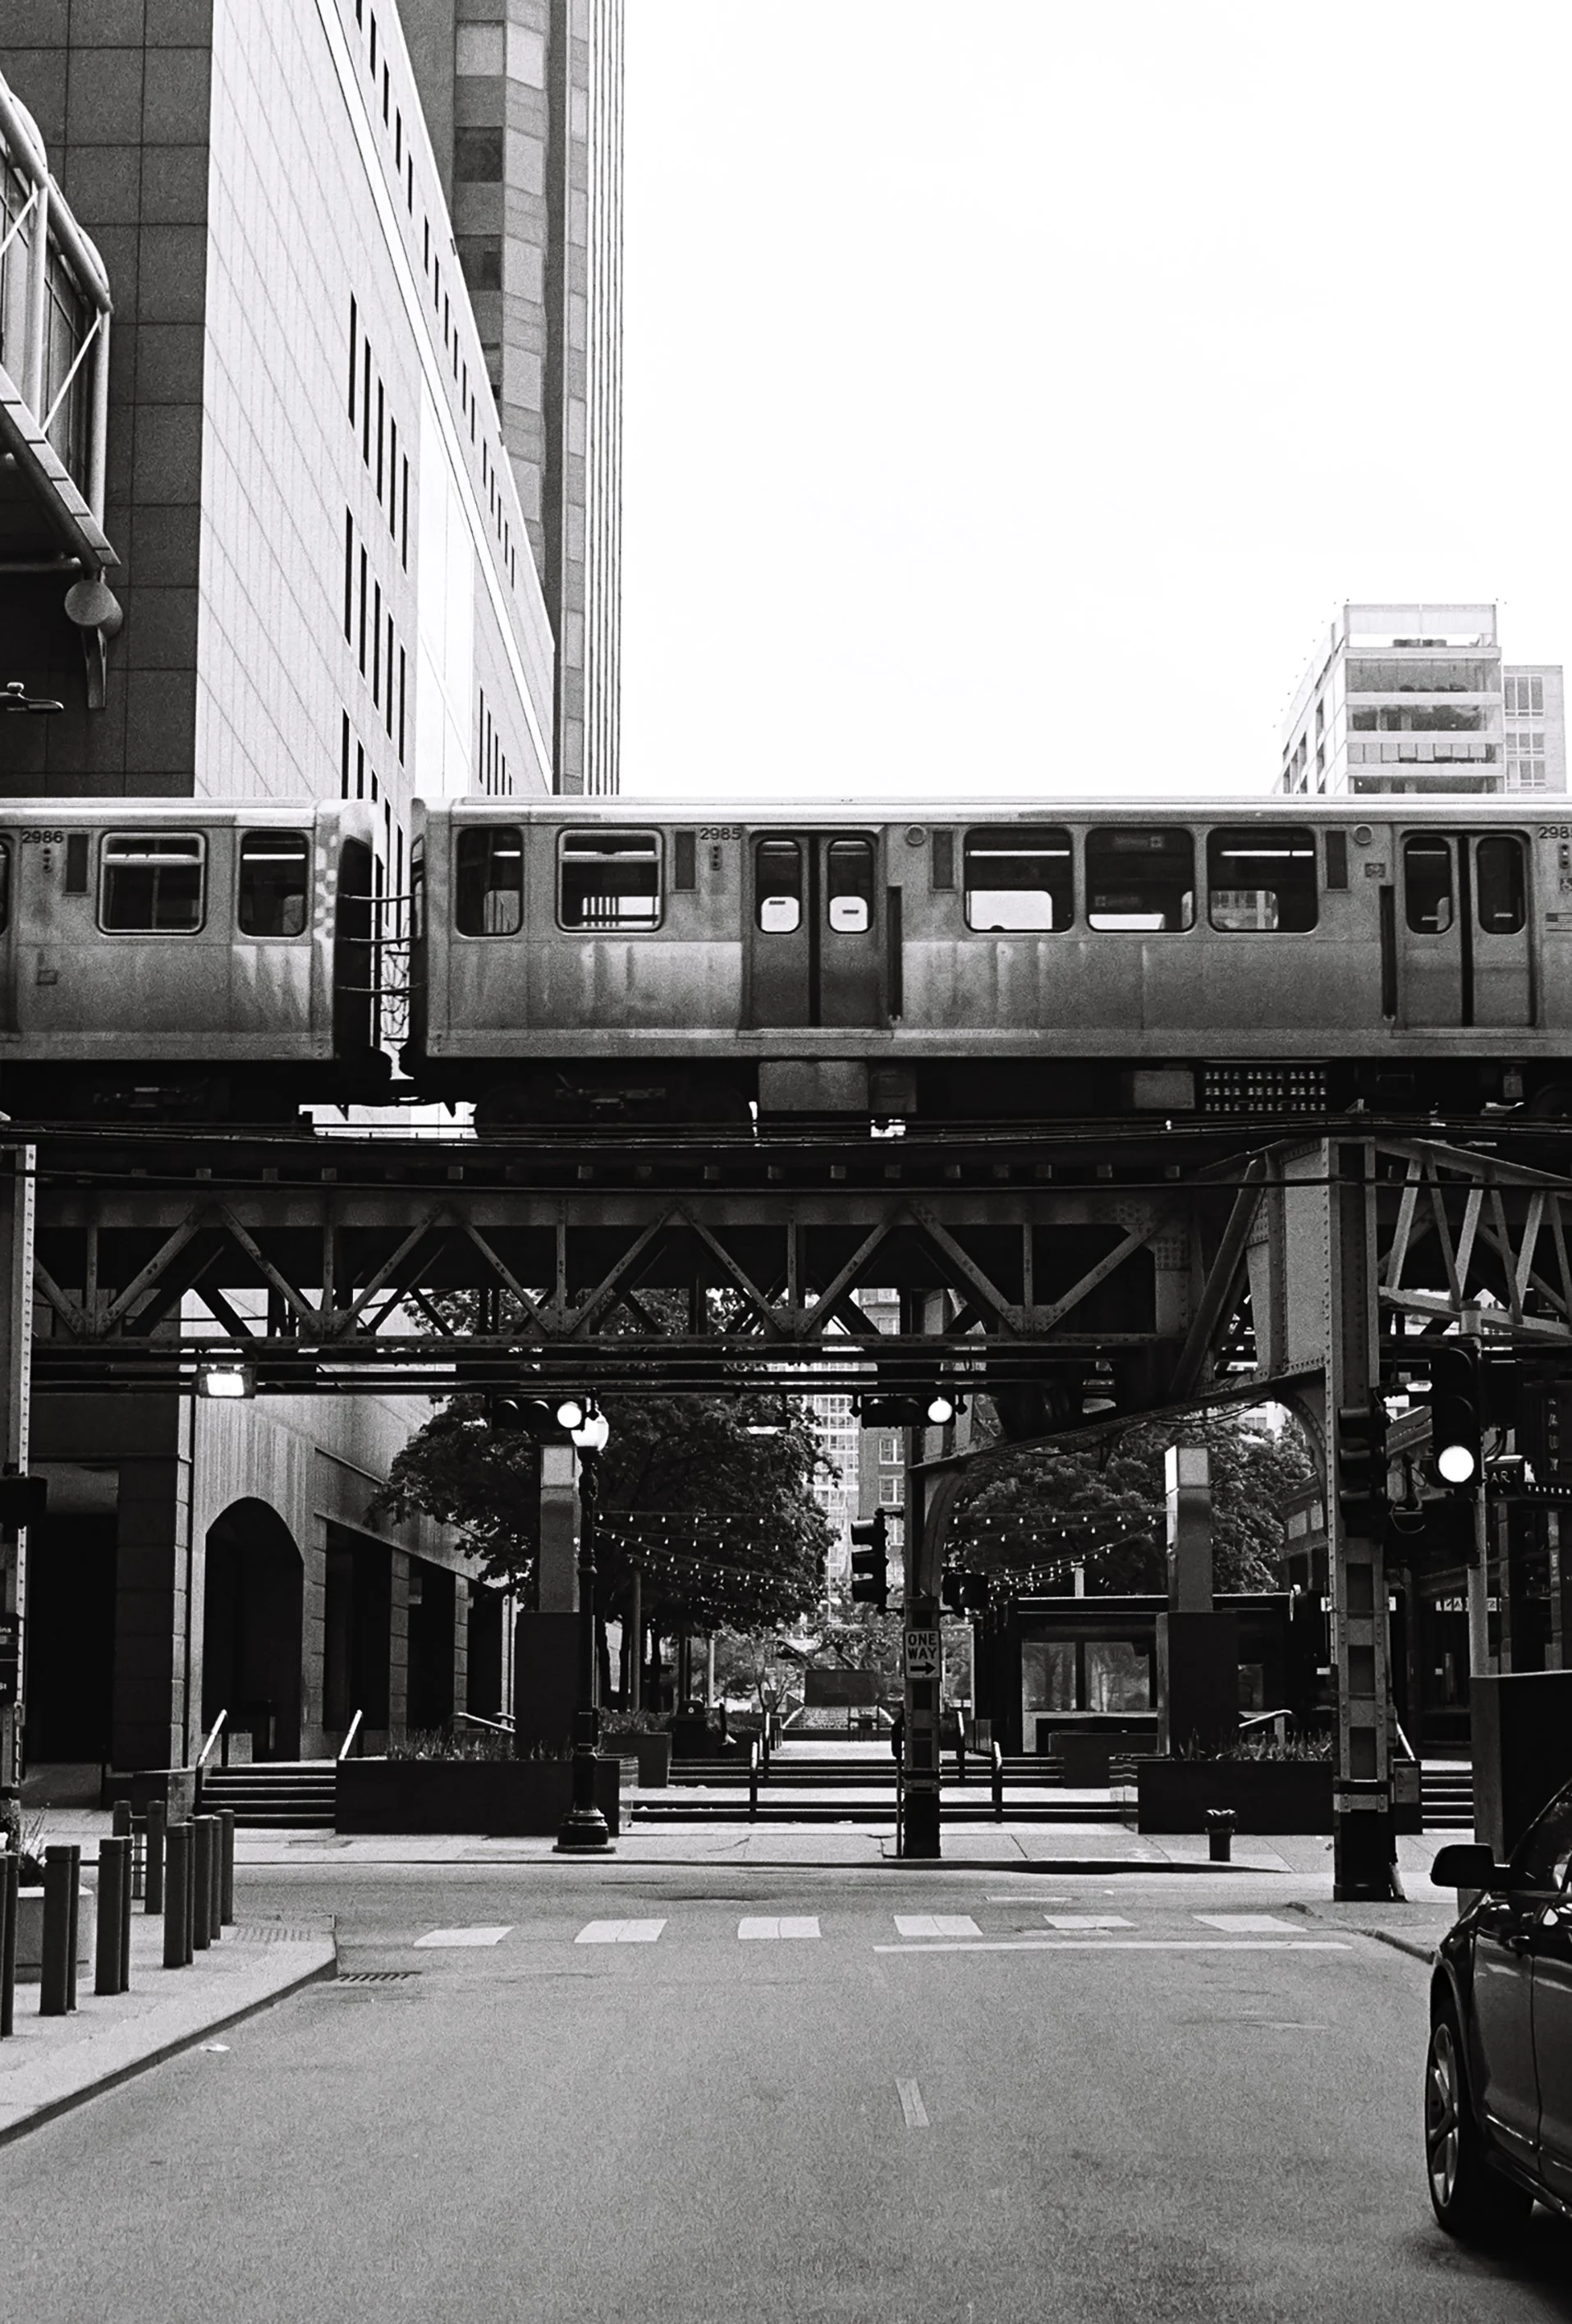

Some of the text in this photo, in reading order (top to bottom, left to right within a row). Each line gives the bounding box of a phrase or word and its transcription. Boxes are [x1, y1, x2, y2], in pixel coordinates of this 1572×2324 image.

[22, 830, 63, 844] 2986
[699, 827, 741, 841] 2985
[1538, 826, 1572, 839] 298
[908, 1633, 937, 1646] ONE
[907, 1647, 937, 1660] WAY
